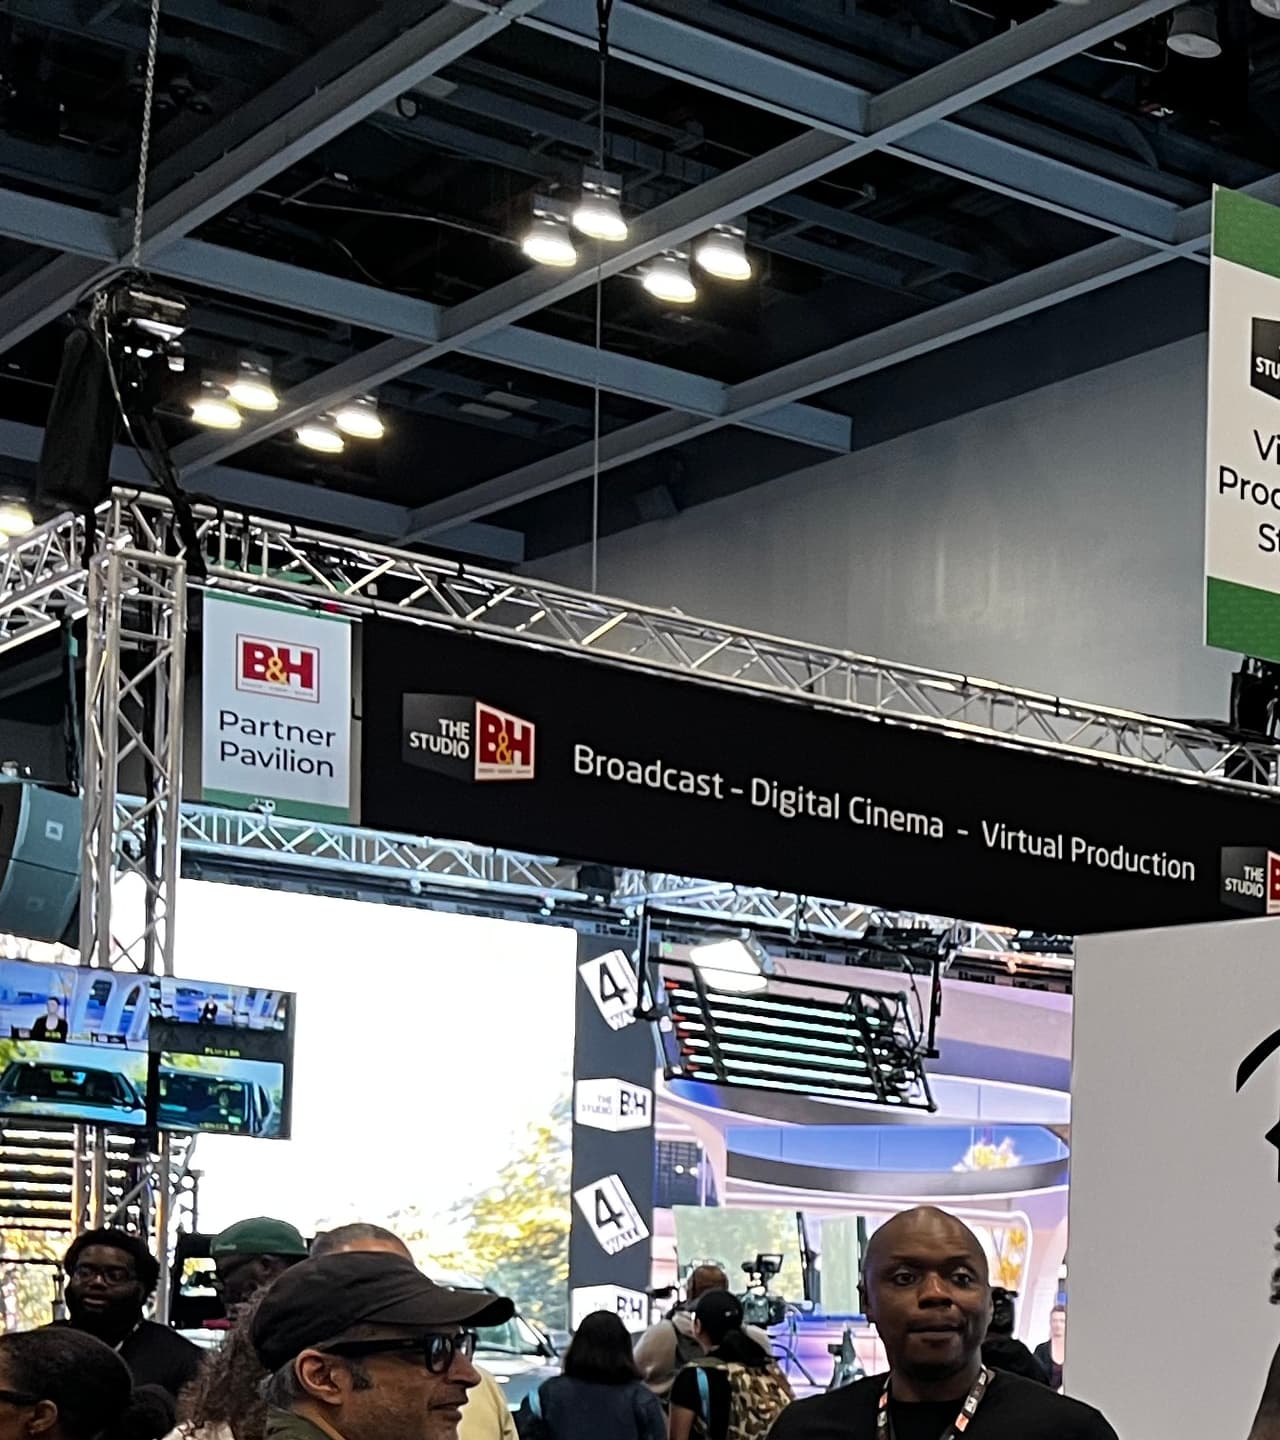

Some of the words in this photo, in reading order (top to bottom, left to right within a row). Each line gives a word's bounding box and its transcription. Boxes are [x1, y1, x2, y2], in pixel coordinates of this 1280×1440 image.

[243, 640, 314, 690] B&H
[219, 710, 337, 748] Partner
[409, 731, 470, 759] STUDIO
[438, 718, 471, 741] THE
[479, 709, 532, 767] B&H
[220, 740, 335, 778] Pavilion
[573, 744, 724, 799] Broadcast
[751, 777, 840, 818] Digital
[849, 796, 944, 838] Cinema
[981, 820, 1063, 860] Virtual
[1071, 836, 1196, 881] Production
[1225, 877, 1264, 898] STUDIO
[1243, 866, 1264, 882] THE
